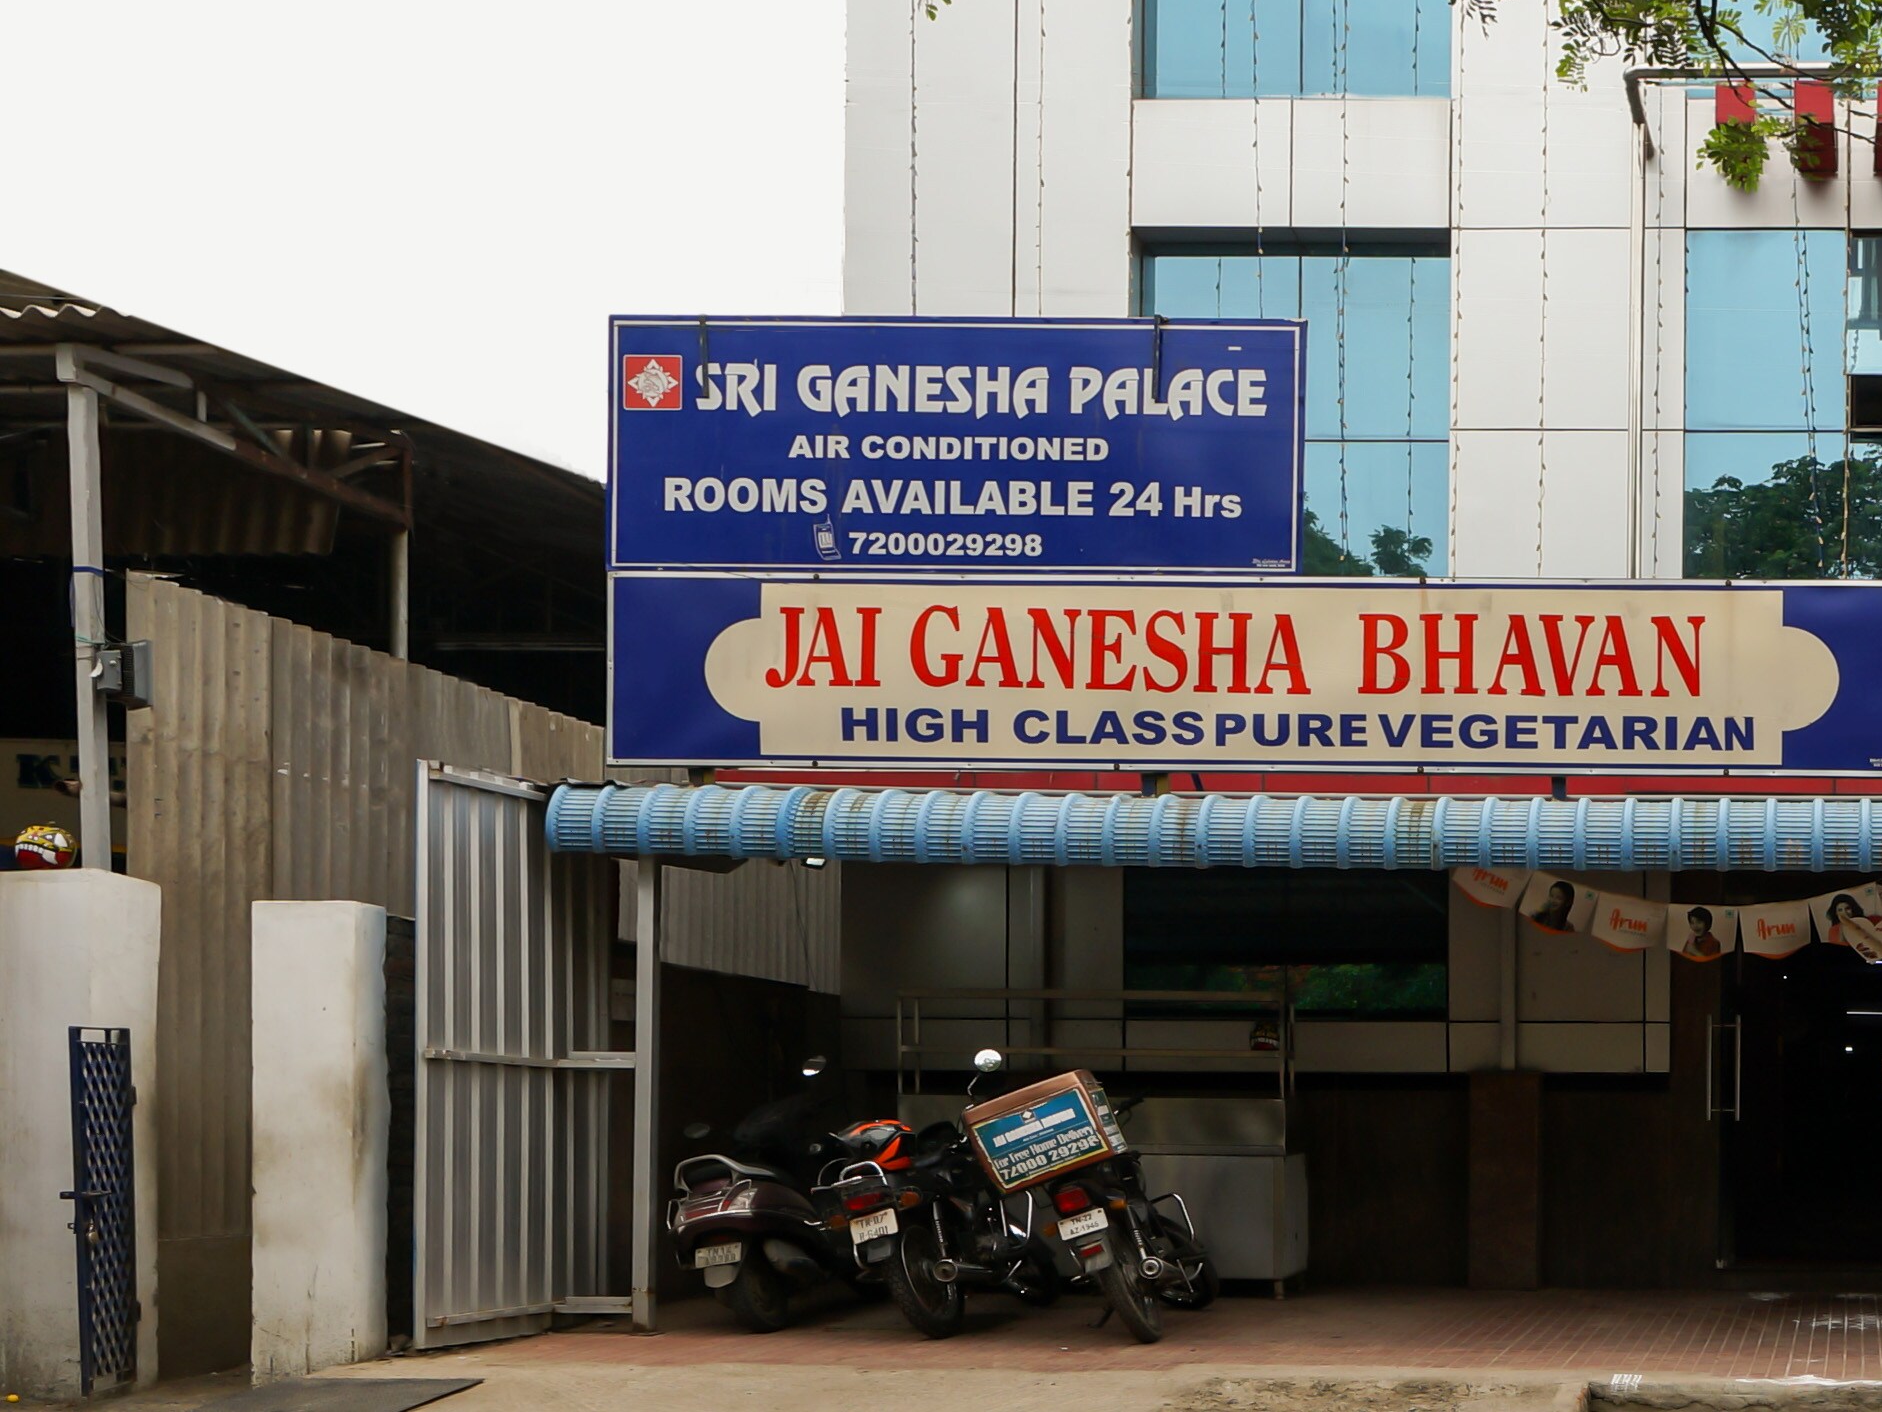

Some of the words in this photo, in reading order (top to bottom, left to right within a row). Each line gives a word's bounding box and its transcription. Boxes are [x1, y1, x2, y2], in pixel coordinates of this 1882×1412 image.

[695, 360, 777, 417] SRI
[796, 364, 1050, 419] GANESHA
[1069, 366, 1268, 421] PALACE
[788, 435, 850, 459] AIR
[861, 435, 1109, 461] CONDITIONED
[664, 477, 828, 514] ROOMS
[841, 479, 1094, 516] AVAILABLE
[1108, 481, 1163, 517] 24
[1174, 486, 1242, 519] Hrs
[848, 532, 1043, 557] 7200029298
[764, 606, 882, 689] JAI
[909, 604, 1312, 695] GANESHA
[1357, 613, 1706, 698] BHAVAN
[841, 707, 989, 743] HIGH
[1013, 709, 1205, 746] CLASS
[1215, 713, 1368, 747] PURE
[1378, 713, 1755, 751] VEGETARIAN
[1609, 908, 1648, 931] Arun
[1756, 918, 1796, 940] Arun
[1030, 1139, 1058, 1158] Home
